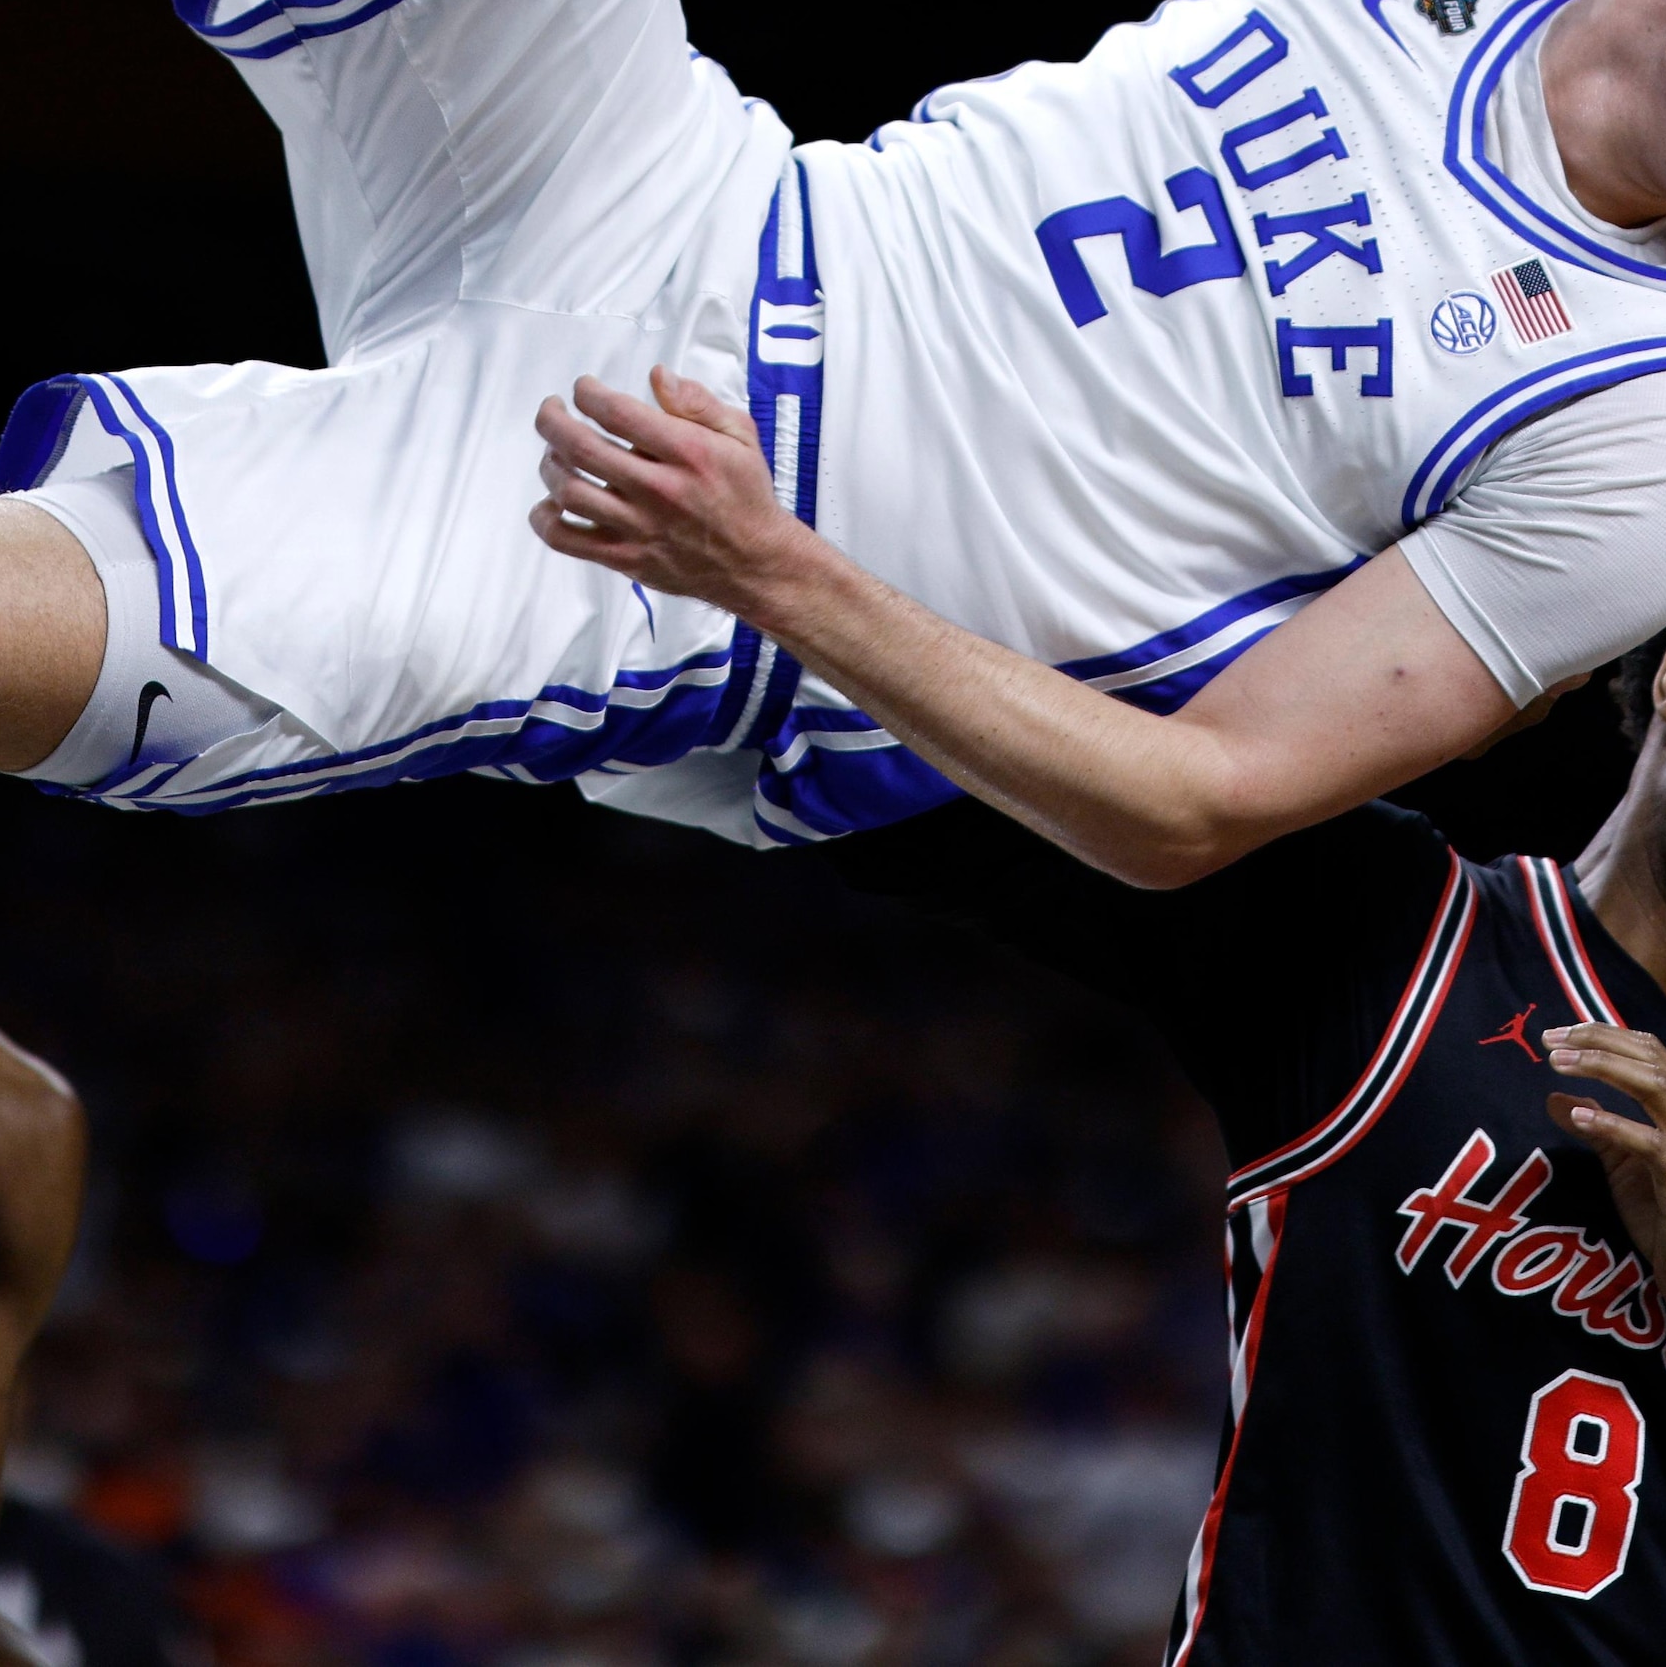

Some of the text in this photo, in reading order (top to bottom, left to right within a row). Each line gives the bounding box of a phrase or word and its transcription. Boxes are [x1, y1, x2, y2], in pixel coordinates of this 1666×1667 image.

[1443, 0, 1467, 31] FOUR
[1035, 166, 1247, 328] 2
[1168, 9, 1394, 398] DUKE
[1453, 301, 1483, 348] ACC
[1501, 1368, 1645, 1600] 8
